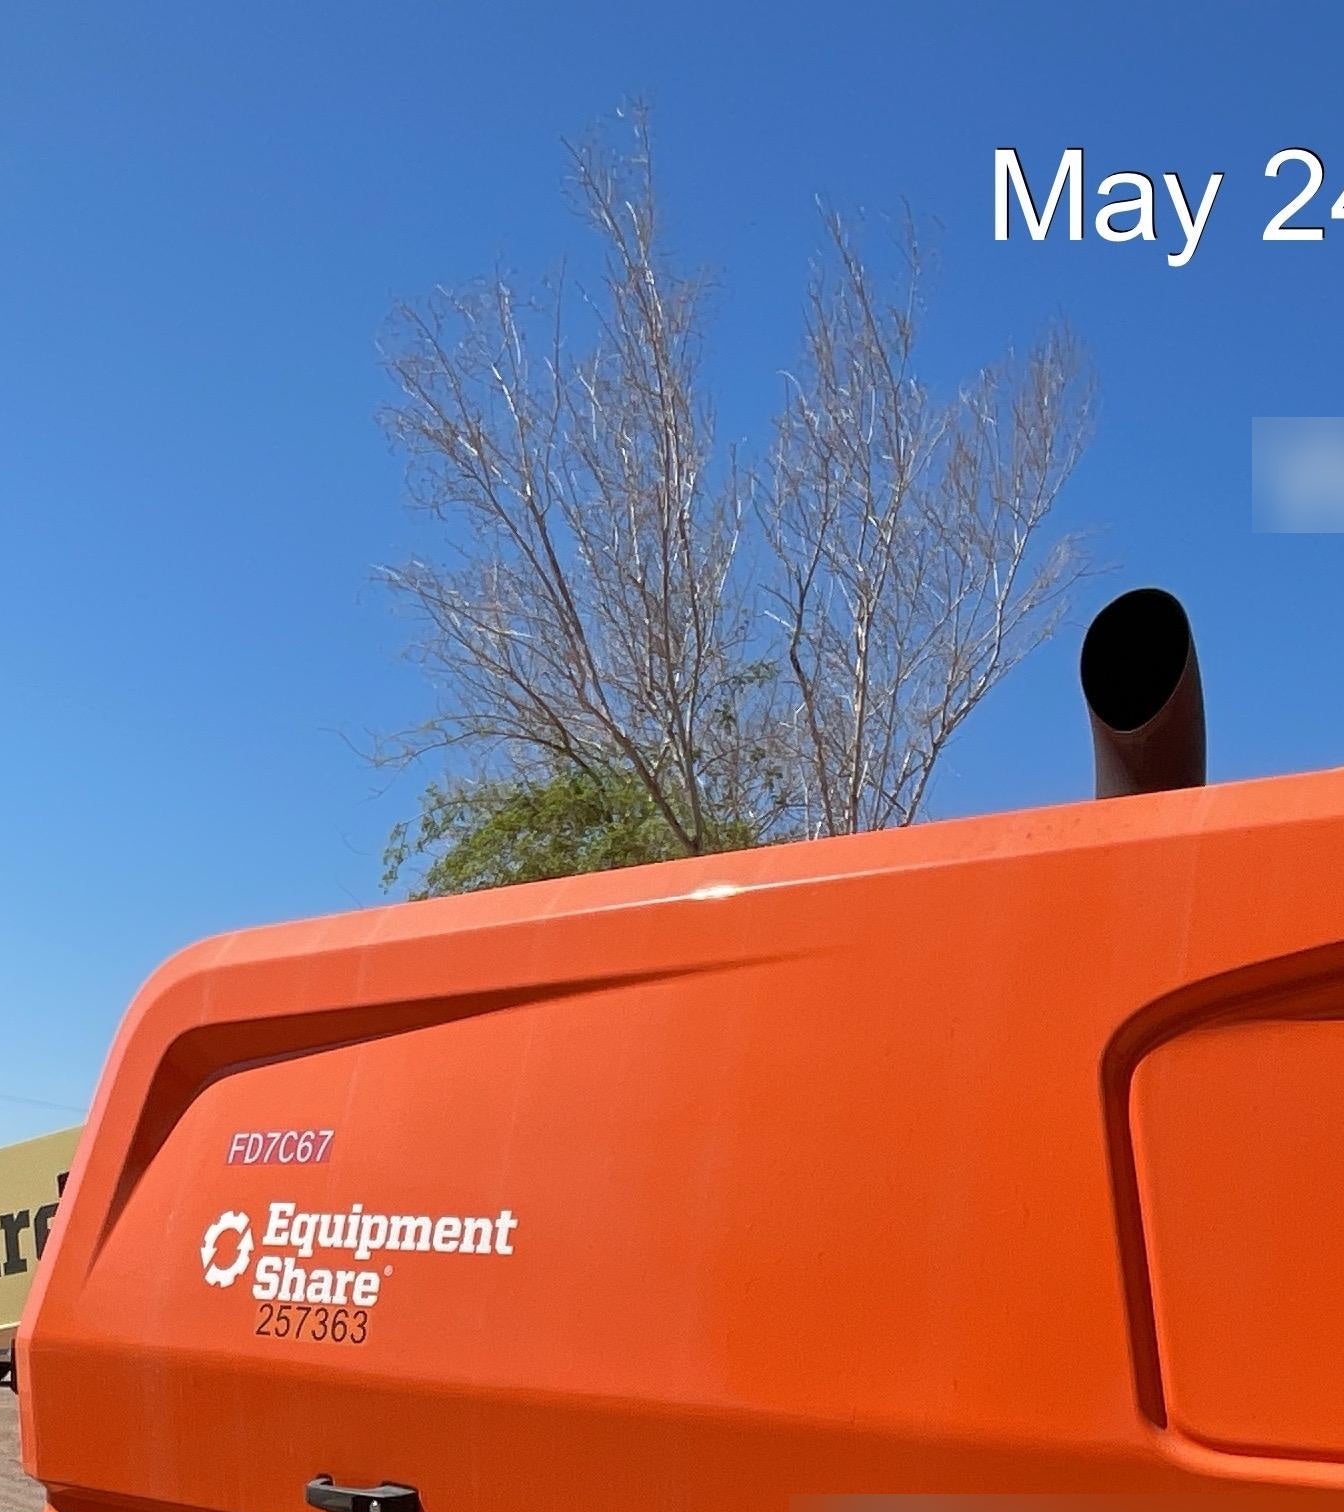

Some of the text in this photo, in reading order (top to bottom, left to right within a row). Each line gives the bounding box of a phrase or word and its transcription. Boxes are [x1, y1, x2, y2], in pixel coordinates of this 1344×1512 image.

[227, 1129, 335, 1165] FD7C67
[261, 1201, 519, 1261] Equipment
[251, 1256, 382, 1308] Share
[254, 1303, 369, 1345] 257363
